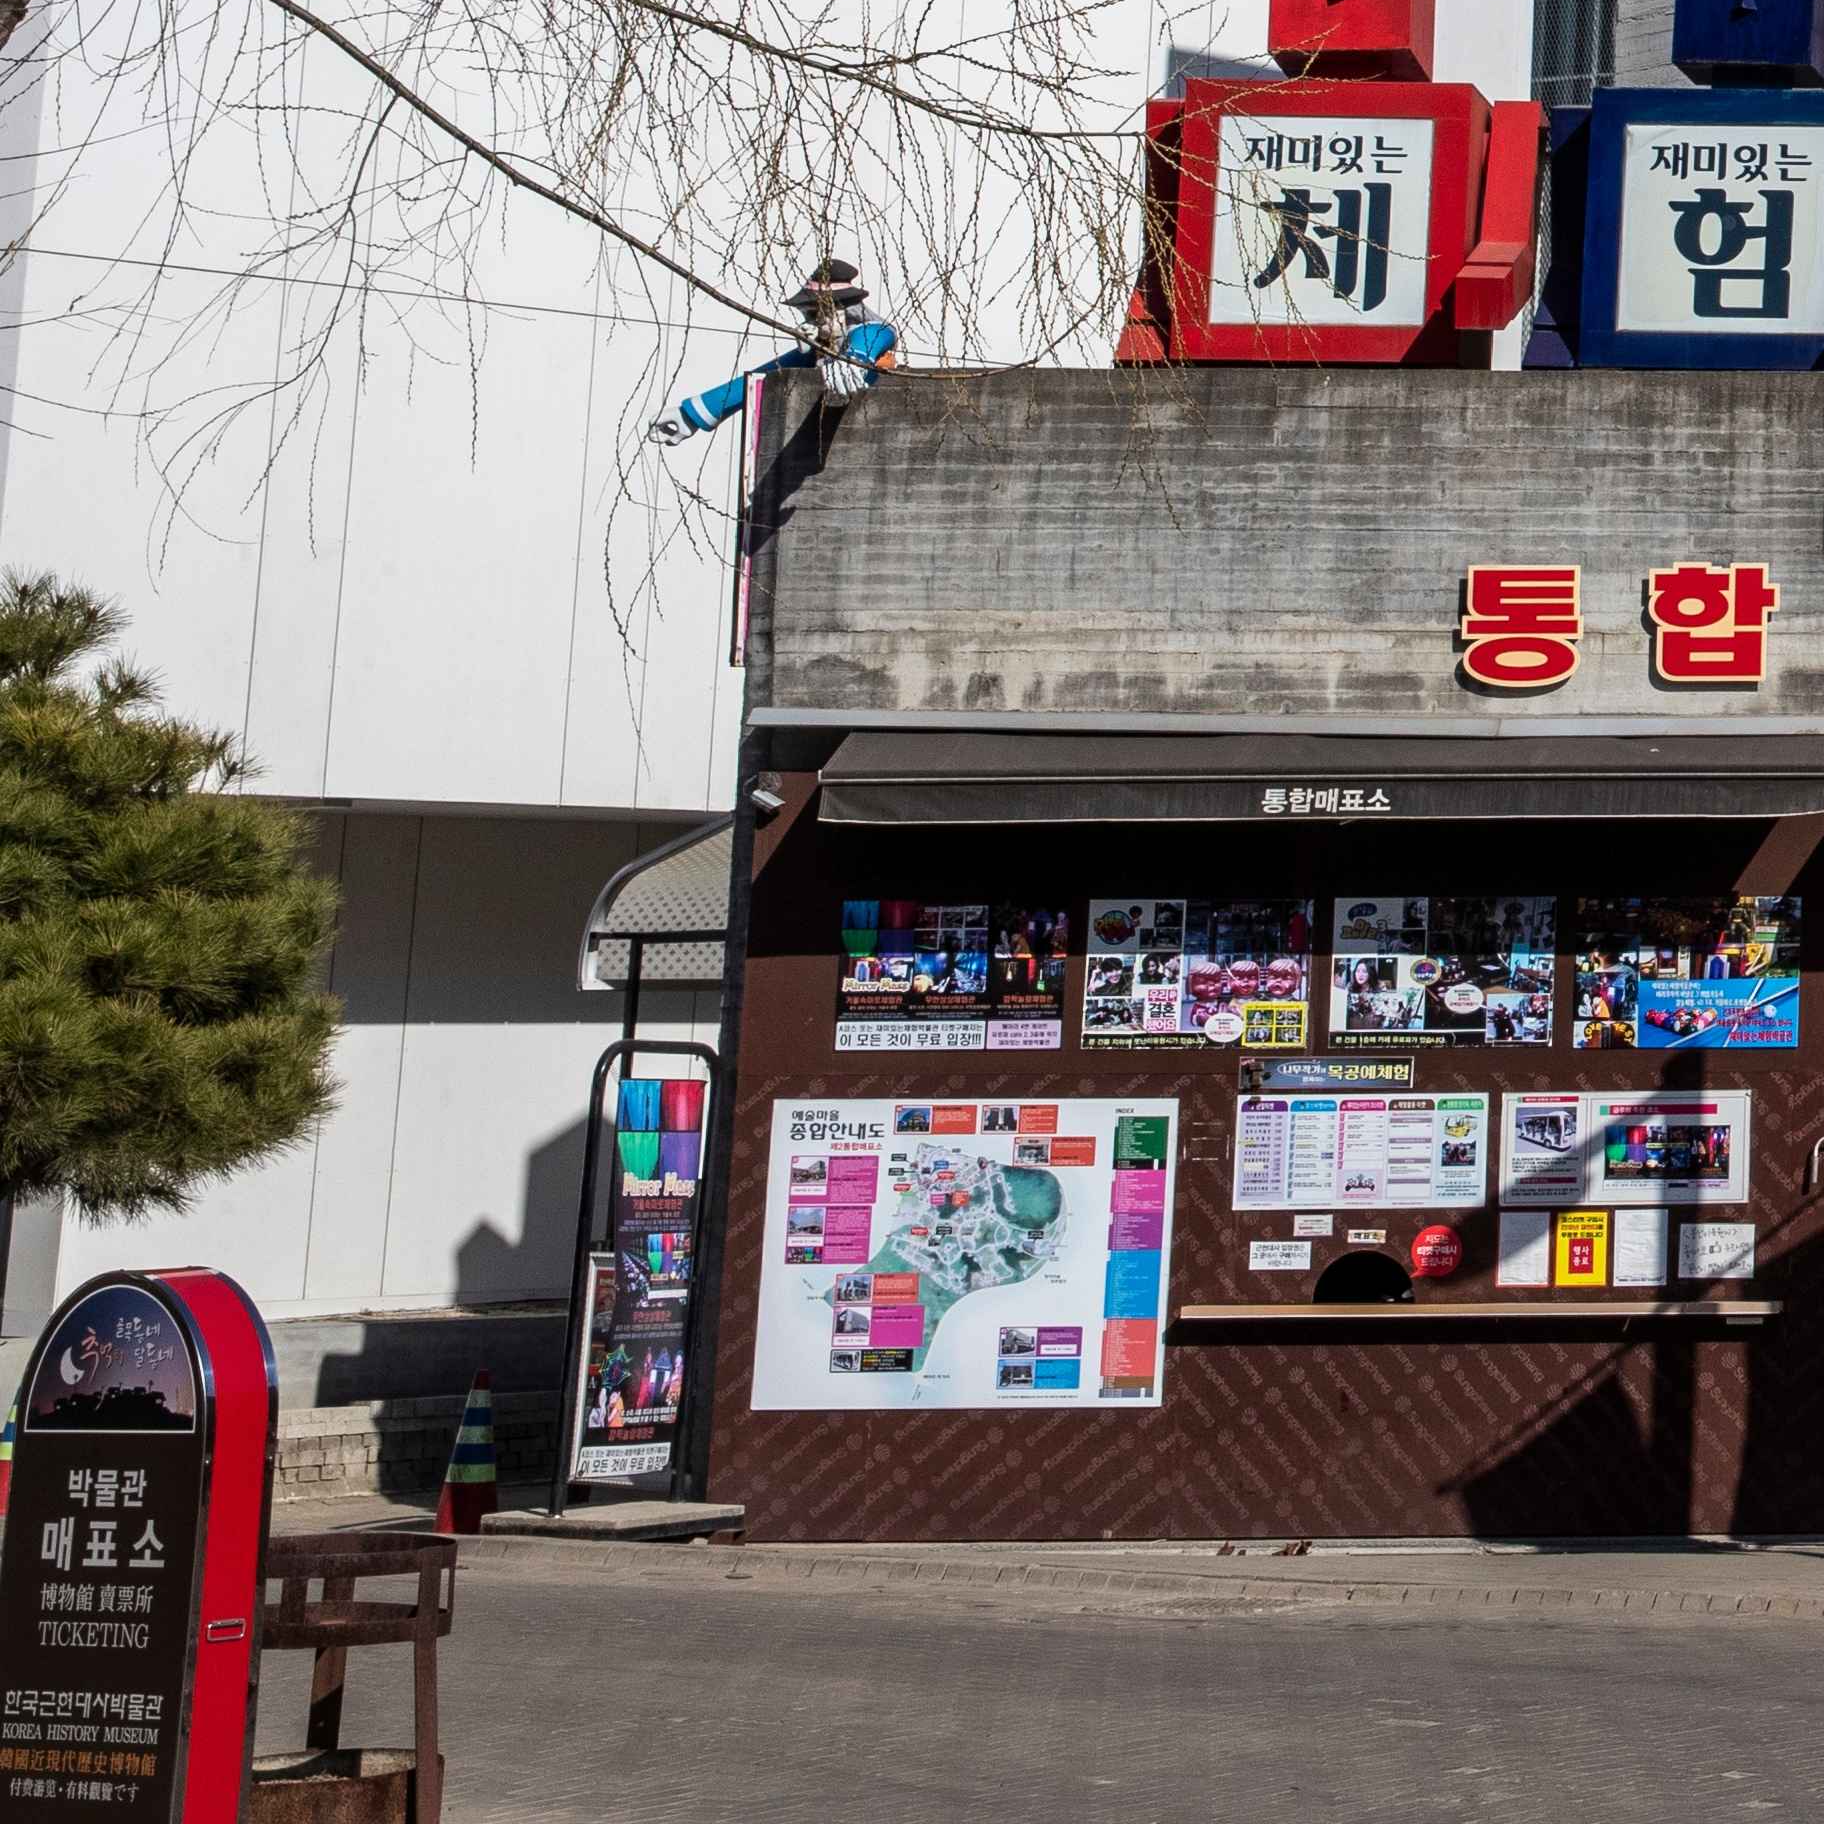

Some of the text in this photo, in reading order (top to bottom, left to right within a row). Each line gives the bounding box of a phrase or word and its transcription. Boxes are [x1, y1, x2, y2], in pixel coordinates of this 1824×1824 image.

[1245, 134, 1409, 172] 재미있는
[1648, 142, 1814, 183] 재미있는
[1254, 184, 1391, 314] 체
[1671, 188, 1795, 321] 험
[1261, 786, 1392, 815] 통합매표소
[1148, 1003, 1176, 1018] 결혼
[840, 1033, 852, 1047] 이
[857, 1033, 882, 1047] 모든
[886, 1033, 911, 1047] 것이
[917, 1033, 942, 1046] 무료
[1328, 1064, 1409, 1081] 목공예체험
[790, 1122, 885, 1141] 종합안내도
[792, 1110, 840, 1123] 예술마을
[68, 1468, 148, 1508] 박물관
[41, 1516, 166, 1572] 매표소
[40, 1582, 155, 1614] 博物館 賣票所
[38, 1620, 150, 1649] TICKETING
[4, 1689, 165, 1721] 한국근현대사박물관
[2, 1722, 159, 1745] KOREA HISTORY MUSEUM
